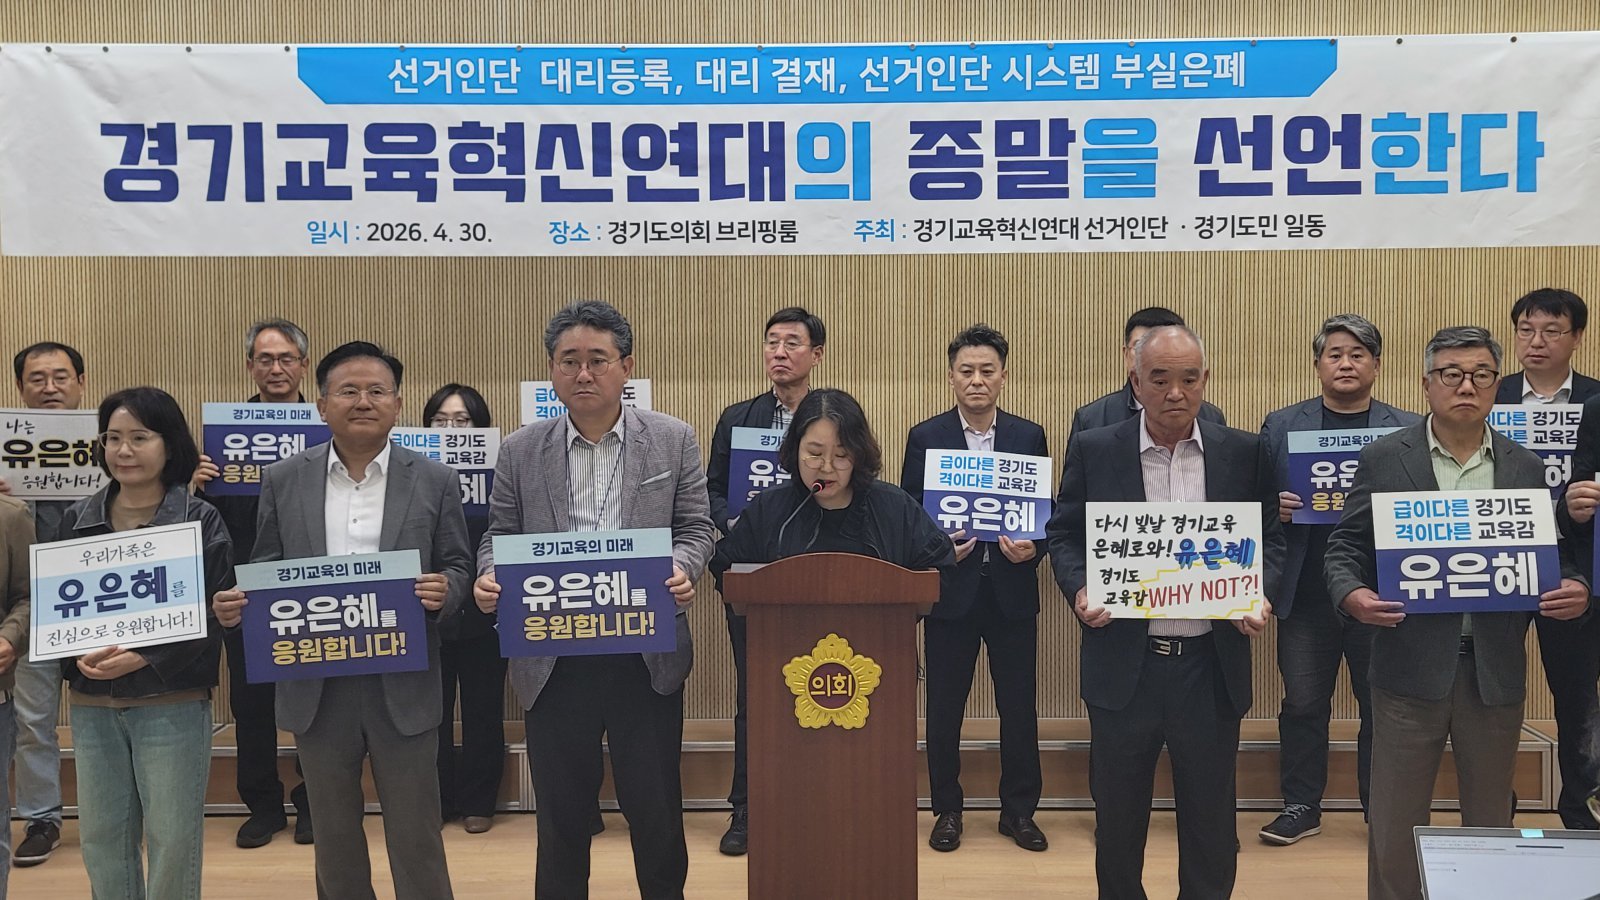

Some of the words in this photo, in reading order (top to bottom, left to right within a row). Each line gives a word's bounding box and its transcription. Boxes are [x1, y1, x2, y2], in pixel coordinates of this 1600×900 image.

[388, 57, 521, 94] 선거인단
[540, 57, 683, 95] 대리등록,
[696, 57, 759, 94] 대리
[771, 57, 847, 94] 결재,
[859, 55, 992, 92] 선거인단
[1002, 53, 1100, 91] 시스템
[1111, 51, 1245, 89] 부실은폐
[100, 121, 872, 203] 경기교육혁신연대의
[908, 116, 1159, 201] 종말을
[1193, 110, 1546, 198] 선언한다
[306, 220, 349, 245] 일시
[366, 222, 428, 243] 2026.
[432, 222, 454, 243] 4.
[459, 222, 493, 243] 30.
[549, 220, 591, 245] 장소
[608, 220, 710, 245] 경기도의회
[715, 219, 799, 244] 브리핑룸
[853, 218, 895, 242] 주최
[913, 217, 1079, 243] 경기교육혁신연대
[1084, 216, 1169, 240] 선거인단
[1194, 214, 1278, 240] 경기도민
[1283, 213, 1327, 239] 일동
[6, 418, 36, 435] 나는
[233, 409, 287, 420] 경기교육의
[290, 409, 312, 420] 미래
[1532, 411, 1580, 426] 경기도
[223, 433, 306, 461] 유은혜
[445, 434, 486, 448] 경기도
[1318, 435, 1373, 447] 경기교육의
[445, 451, 487, 465] 교육감
[940, 455, 995, 471] 급이다른
[999, 459, 1038, 475] 경기도
[22, 471, 102, 490] 응원합니다!
[939, 472, 994, 489] 격이다른
[997, 475, 1038, 493] 교육감
[937, 495, 1036, 533] 유은혜
[1393, 498, 1470, 519] 급이다른
[1475, 498, 1533, 517] 경기도
[1095, 514, 1129, 533] 다시
[1135, 513, 1166, 534] 빛날
[1171, 513, 1237, 534] 경기교육
[1395, 522, 1472, 542] 격이다른
[1478, 520, 1535, 540] 교육감
[80, 541, 157, 567] 우리가족은
[531, 539, 601, 557] 경기교육의
[606, 538, 634, 553] 미래
[1092, 537, 1174, 559] 은혜로와!
[1173, 537, 1257, 570] 유은혜
[276, 563, 349, 582] 경기교육의
[353, 560, 382, 575] 미래
[1100, 567, 1141, 585] 경기도
[1399, 551, 1539, 600] 유은혜
[522, 570, 648, 612] 유은혜를
[1103, 589, 1149, 607] 교육감
[1148, 582, 1194, 609] WHY
[1201, 574, 1259, 602] NOT?!
[269, 592, 398, 636] 유은혜를
[523, 611, 656, 641] 응원합니다!
[46, 624, 110, 647] 진심으로
[112, 610, 194, 638] 응원합니다!
[271, 631, 407, 666] 응원합니다!
[810, 672, 852, 698] 의회
